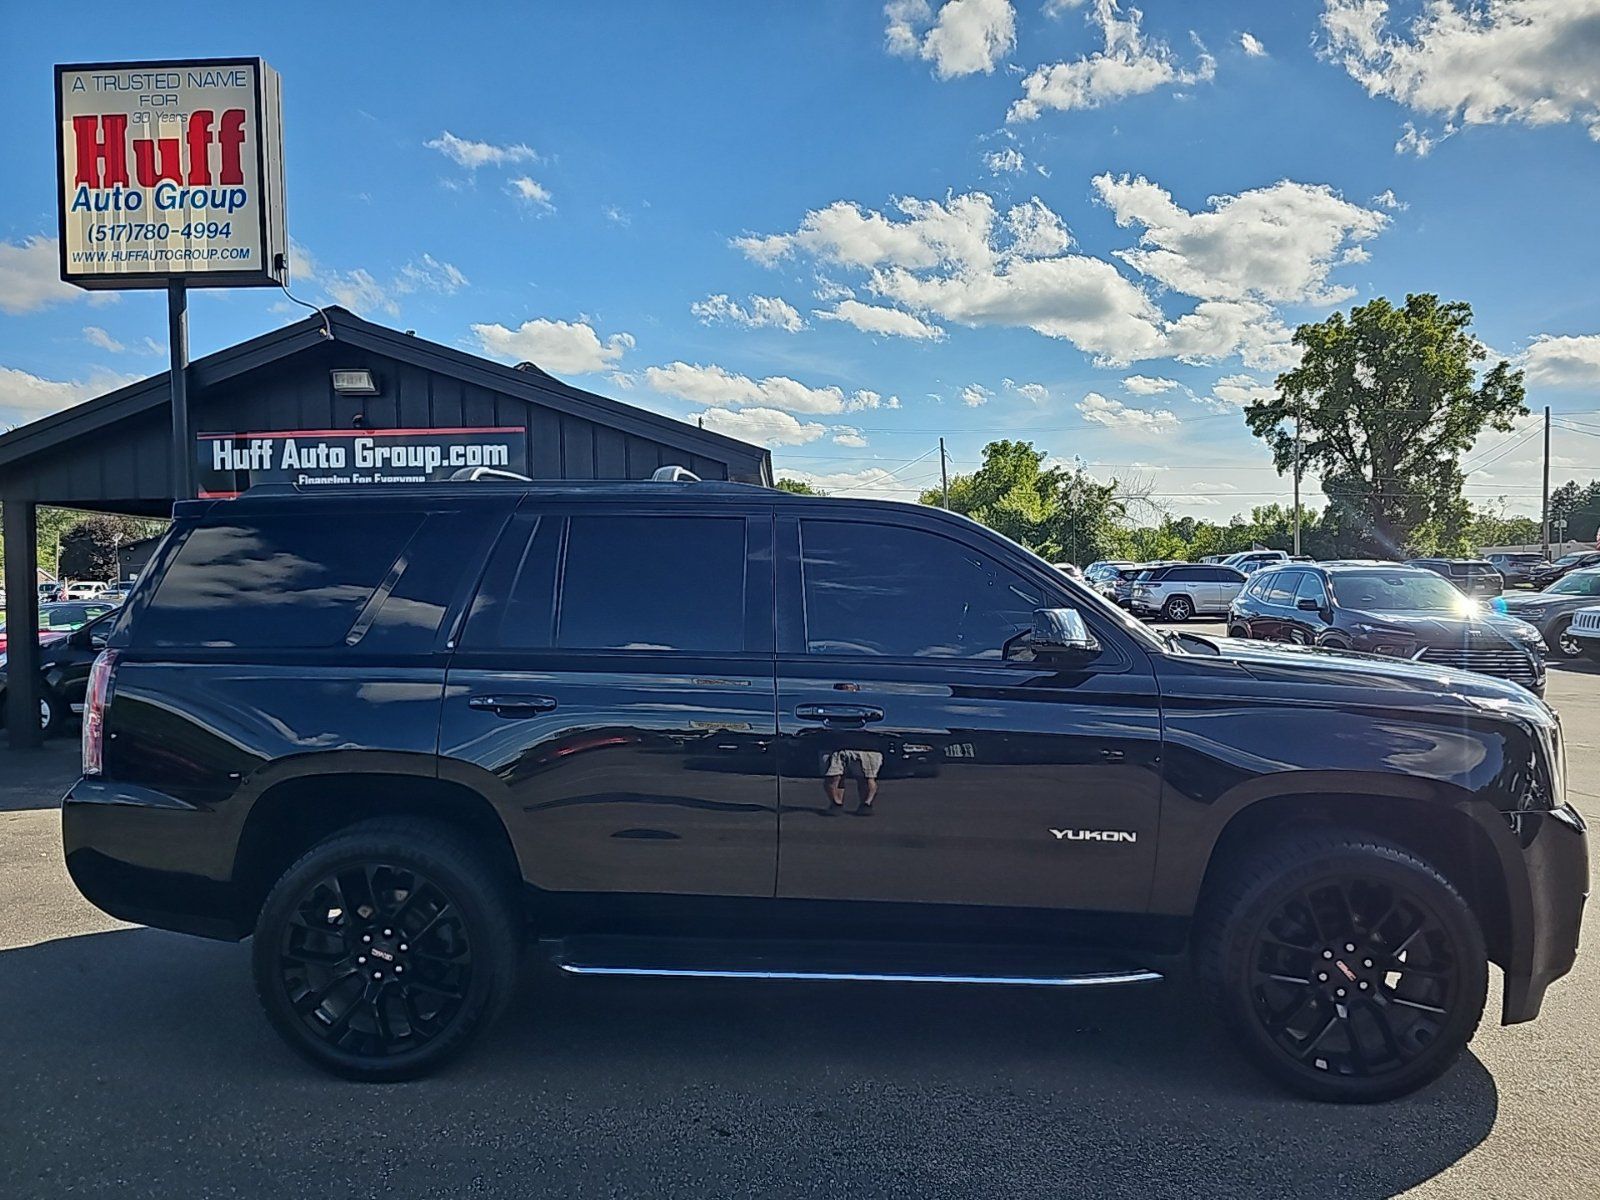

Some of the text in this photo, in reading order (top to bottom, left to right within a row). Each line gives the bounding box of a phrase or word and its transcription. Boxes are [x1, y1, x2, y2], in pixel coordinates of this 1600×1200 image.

[72, 71, 246, 92] A TRUSTED NAME
[140, 95, 178, 107] FOR
[132, 111, 188, 124] 30 Years
[72, 109, 246, 189] Huff
[71, 184, 247, 213] Auto Group
[88, 222, 231, 243] (517)780-4994
[72, 248, 250, 263] WWW.HUFFAUTOGROUP.COM
[212, 438, 508, 473] Huff Auto Group.com
[1049, 828, 1137, 842] YUKON
